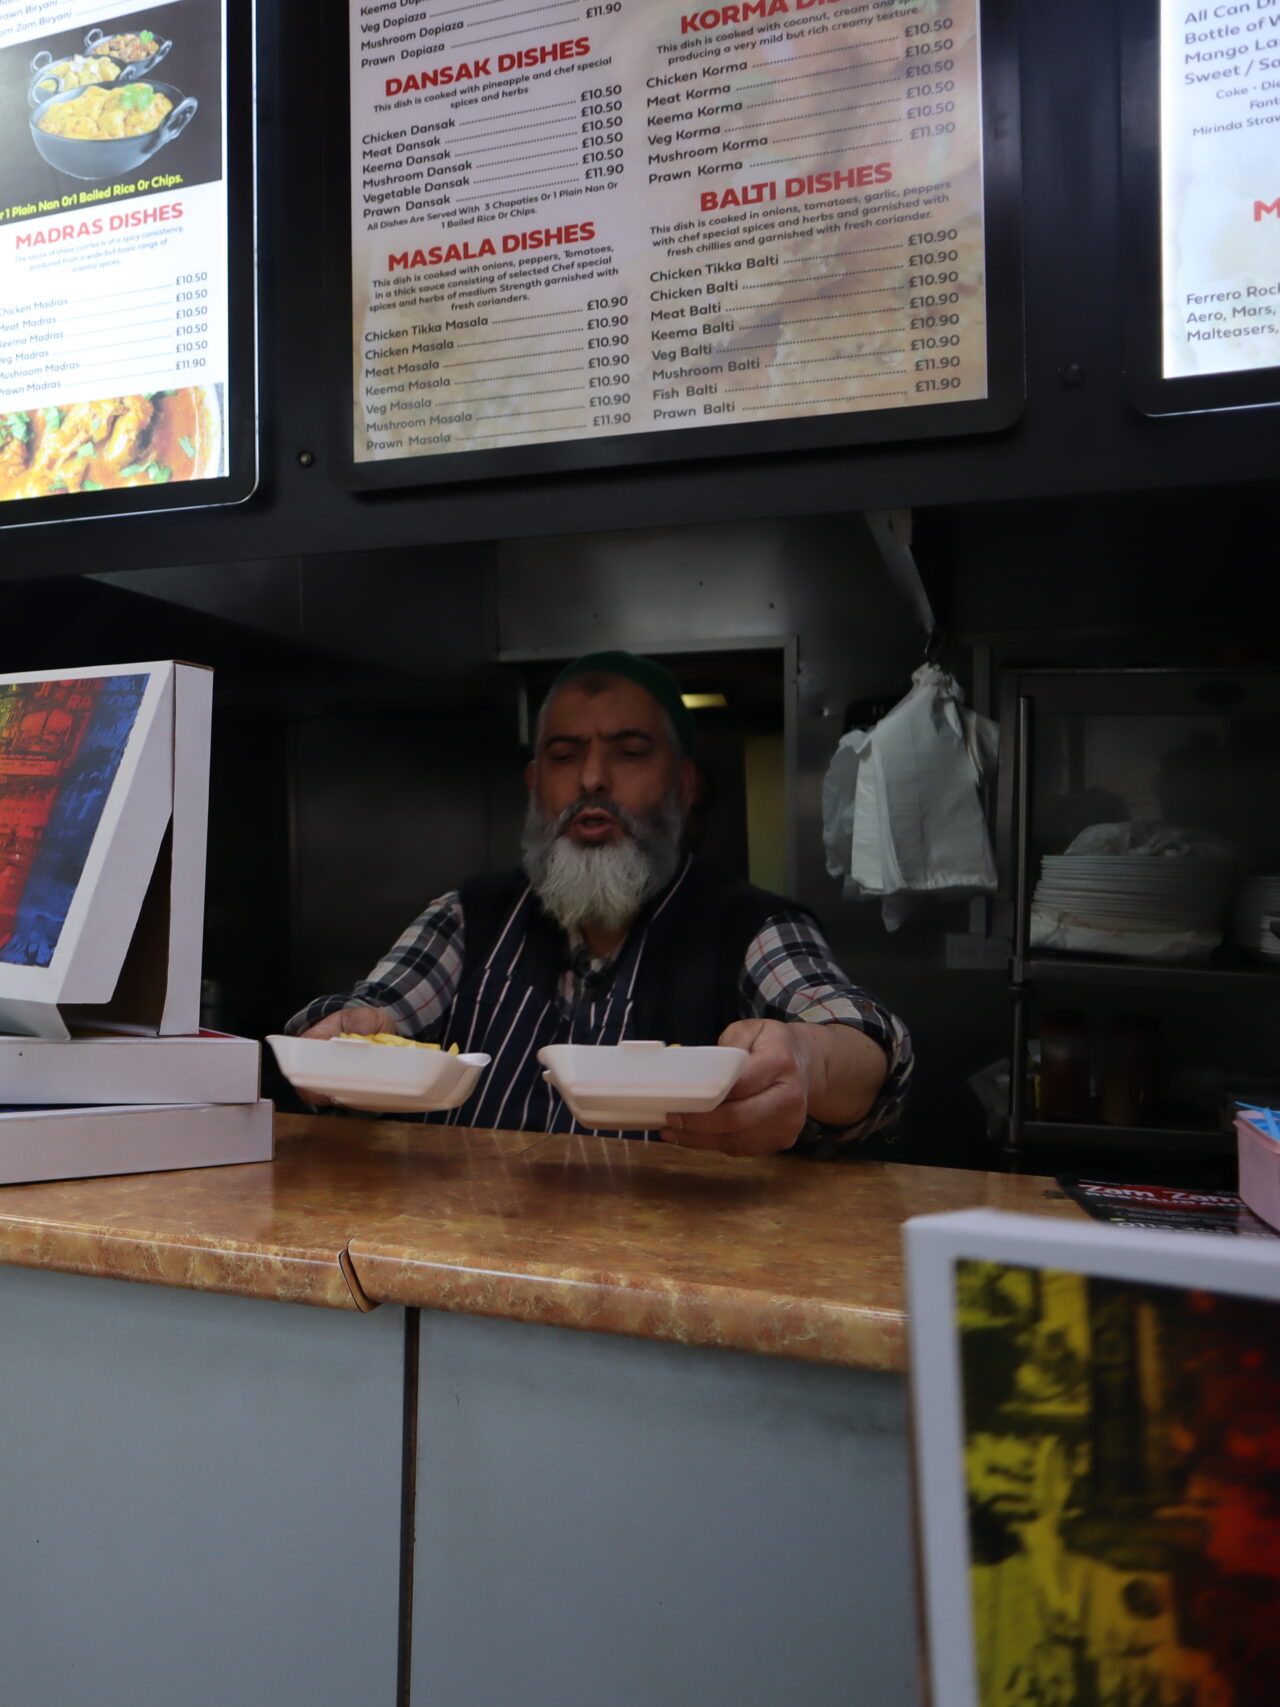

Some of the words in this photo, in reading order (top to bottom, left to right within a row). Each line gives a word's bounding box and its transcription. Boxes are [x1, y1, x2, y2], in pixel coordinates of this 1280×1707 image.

[361, 22, 380, 33] Veg
[383, 12, 426, 28] Dopiaza
[361, 55, 395, 68] Prawn
[401, 44, 445, 59] Dopiaza
[586, 2, 621, 18] £11.90
[681, 0, 789, 34] KORMA
[1185, 9, 1207, 24] All
[1213, 3, 1250, 18] Can
[1185, 25, 1240, 45] Bottle
[1246, 17, 1265, 32] of
[385, 58, 491, 96] DANSAK
[498, 37, 591, 72] DISHES
[646, 71, 697, 88] Chicken
[703, 61, 748, 78] Korma
[904, 18, 953, 38] £10.50
[647, 93, 681, 108] Meat
[686, 83, 731, 99] Korma
[905, 39, 953, 58] £10.50
[1185, 45, 1248, 65] Mango
[1185, 64, 1240, 85] Sweet
[374, 104, 394, 113] This
[394, 98, 412, 109] dish
[424, 89, 456, 102] cooked
[460, 84, 480, 94] with
[482, 75, 530, 91] pineapple
[533, 69, 551, 80] and
[554, 64, 575, 75] chef
[578, 56, 612, 71] special
[1216, 87, 1248, 99] Coke
[1193, 121, 1242, 136] Mirinda
[363, 171, 423, 189] Mushroom
[427, 162, 472, 177] Dansak
[582, 132, 623, 148] £10.50
[649, 169, 691, 185] Prawn
[698, 160, 743, 176] Korma
[910, 122, 955, 140] £11.90
[12, 204, 36, 217] Plain
[39, 198, 60, 211] Nan
[79, 187, 111, 203] Boiled
[113, 183, 135, 195] Rice
[152, 174, 183, 188] Chips.
[363, 186, 421, 204] Vegetable
[425, 177, 469, 193] Dansak
[582, 148, 623, 164] £10.50
[363, 205, 400, 218] Prawn
[405, 195, 450, 211] Dansak
[585, 164, 623, 180] £11.90
[700, 183, 777, 212] BALTI
[785, 162, 893, 199] DISHES
[15, 219, 103, 250] MADRAS
[110, 202, 183, 232] DISHES
[388, 238, 495, 272] MASALA
[502, 221, 595, 254] DISHES
[650, 268, 702, 283] Chicken
[705, 261, 742, 274] Tikka
[747, 254, 779, 269] Balti
[908, 229, 958, 246] £10.90
[34, 297, 68, 310] Madras
[176, 272, 208, 286] £10.50
[1187, 291, 1242, 305] Ferrero
[365, 328, 409, 342] Chicken
[412, 322, 442, 335] Tikka
[446, 317, 488, 330] Masala
[587, 296, 628, 311] £10.90
[1187, 312, 1227, 323] Aero,
[1232, 306, 1276, 318] Mars,
[1187, 324, 1279, 342] Malteasers,
[27, 380, 61, 392] Madras
[176, 358, 206, 371] £11.90
[366, 403, 387, 415] Veg
[390, 398, 432, 412] Masala
[589, 374, 630, 389] £10.90
[653, 389, 679, 400] Fish
[687, 384, 718, 396] Balti
[914, 356, 960, 372] £11.90
[653, 408, 696, 420] Prawn
[704, 402, 735, 414] Balti
[915, 377, 961, 393] £11.90
[1078, 1184, 1155, 1198] Zam
[1163, 1190, 1242, 1203] Zam
